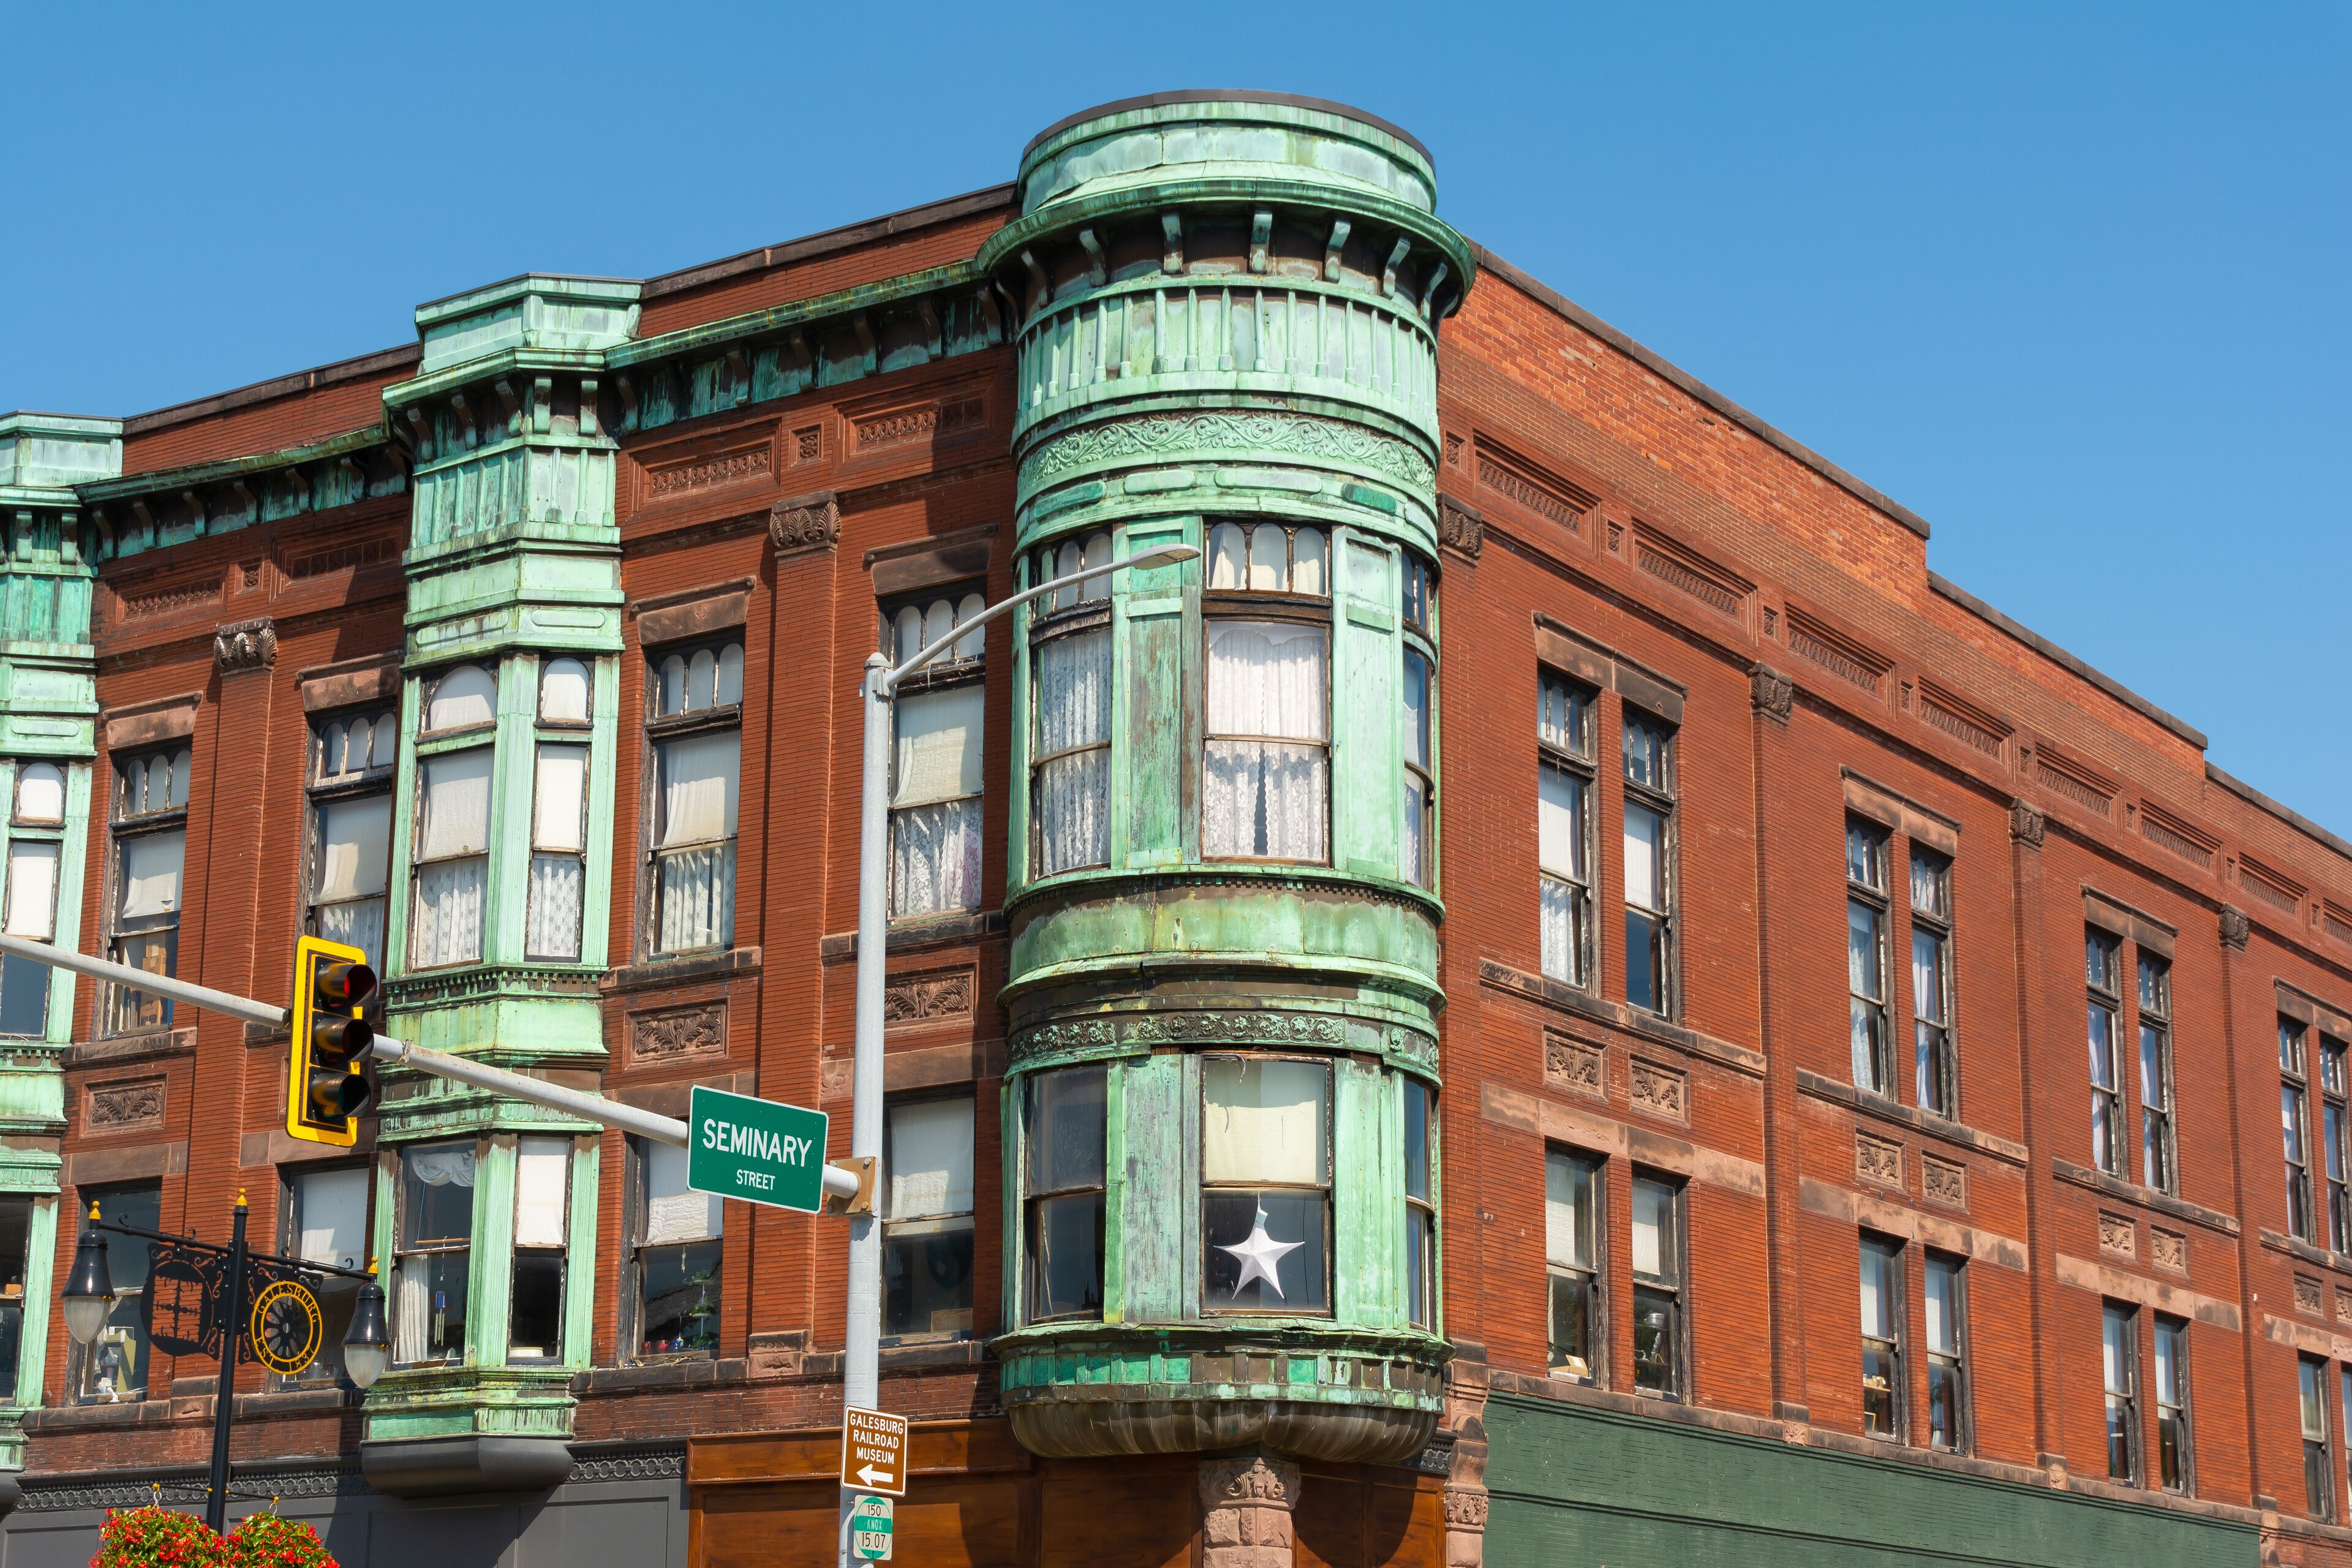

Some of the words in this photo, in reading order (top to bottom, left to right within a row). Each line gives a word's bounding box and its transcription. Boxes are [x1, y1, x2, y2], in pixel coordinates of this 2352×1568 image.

[703, 1118, 812, 1167] SEMINARY
[736, 1169, 775, 1190] STREET
[257, 1283, 320, 1323] GALESBURG
[850, 1413, 903, 1434] GALESBURG
[853, 1429, 899, 1449] RAILROAD
[856, 1446, 894, 1464] MUSEUM
[867, 1504, 881, 1517] 150
[867, 1518, 882, 1531] KNOX
[862, 1532, 886, 1548] 15.07
